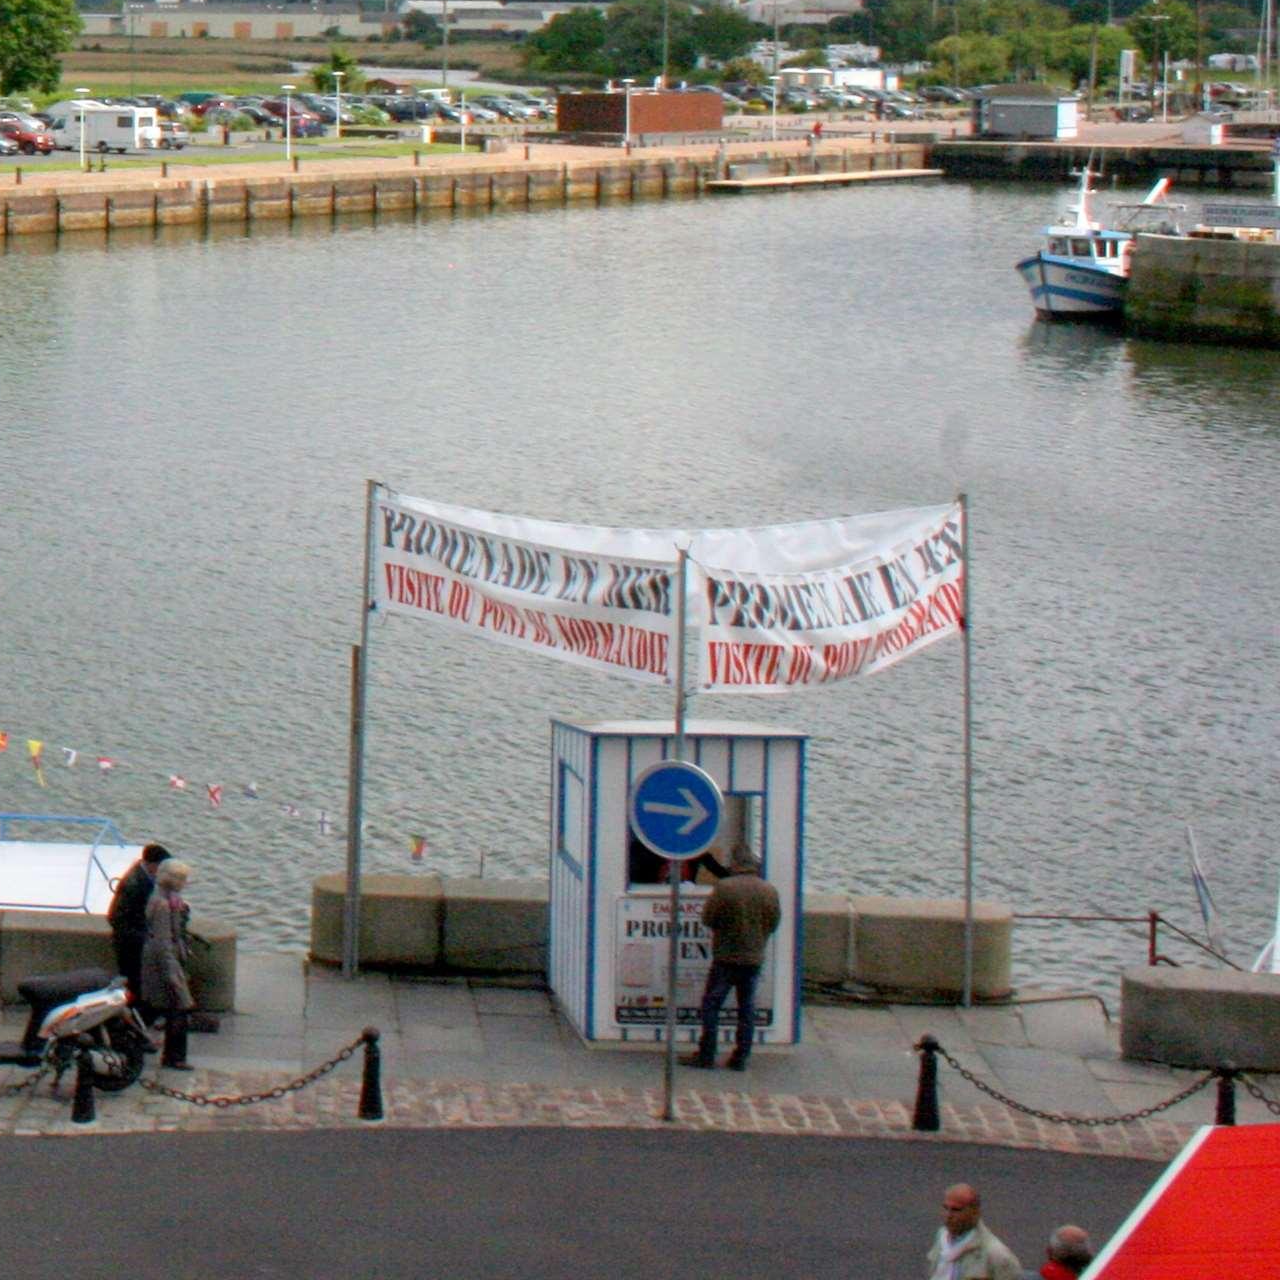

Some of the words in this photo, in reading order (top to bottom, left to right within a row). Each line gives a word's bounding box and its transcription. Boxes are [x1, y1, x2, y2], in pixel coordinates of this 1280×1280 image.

[380, 505, 551, 595] PROMENADE
[557, 555, 599, 604] EN
[602, 563, 671, 616] MER
[384, 562, 445, 614] VISITE
[448, 579, 473, 622] DU
[478, 597, 526, 639] PONT
[553, 614, 670, 677] NORMANDIE
[707, 642, 785, 685] VISITE
